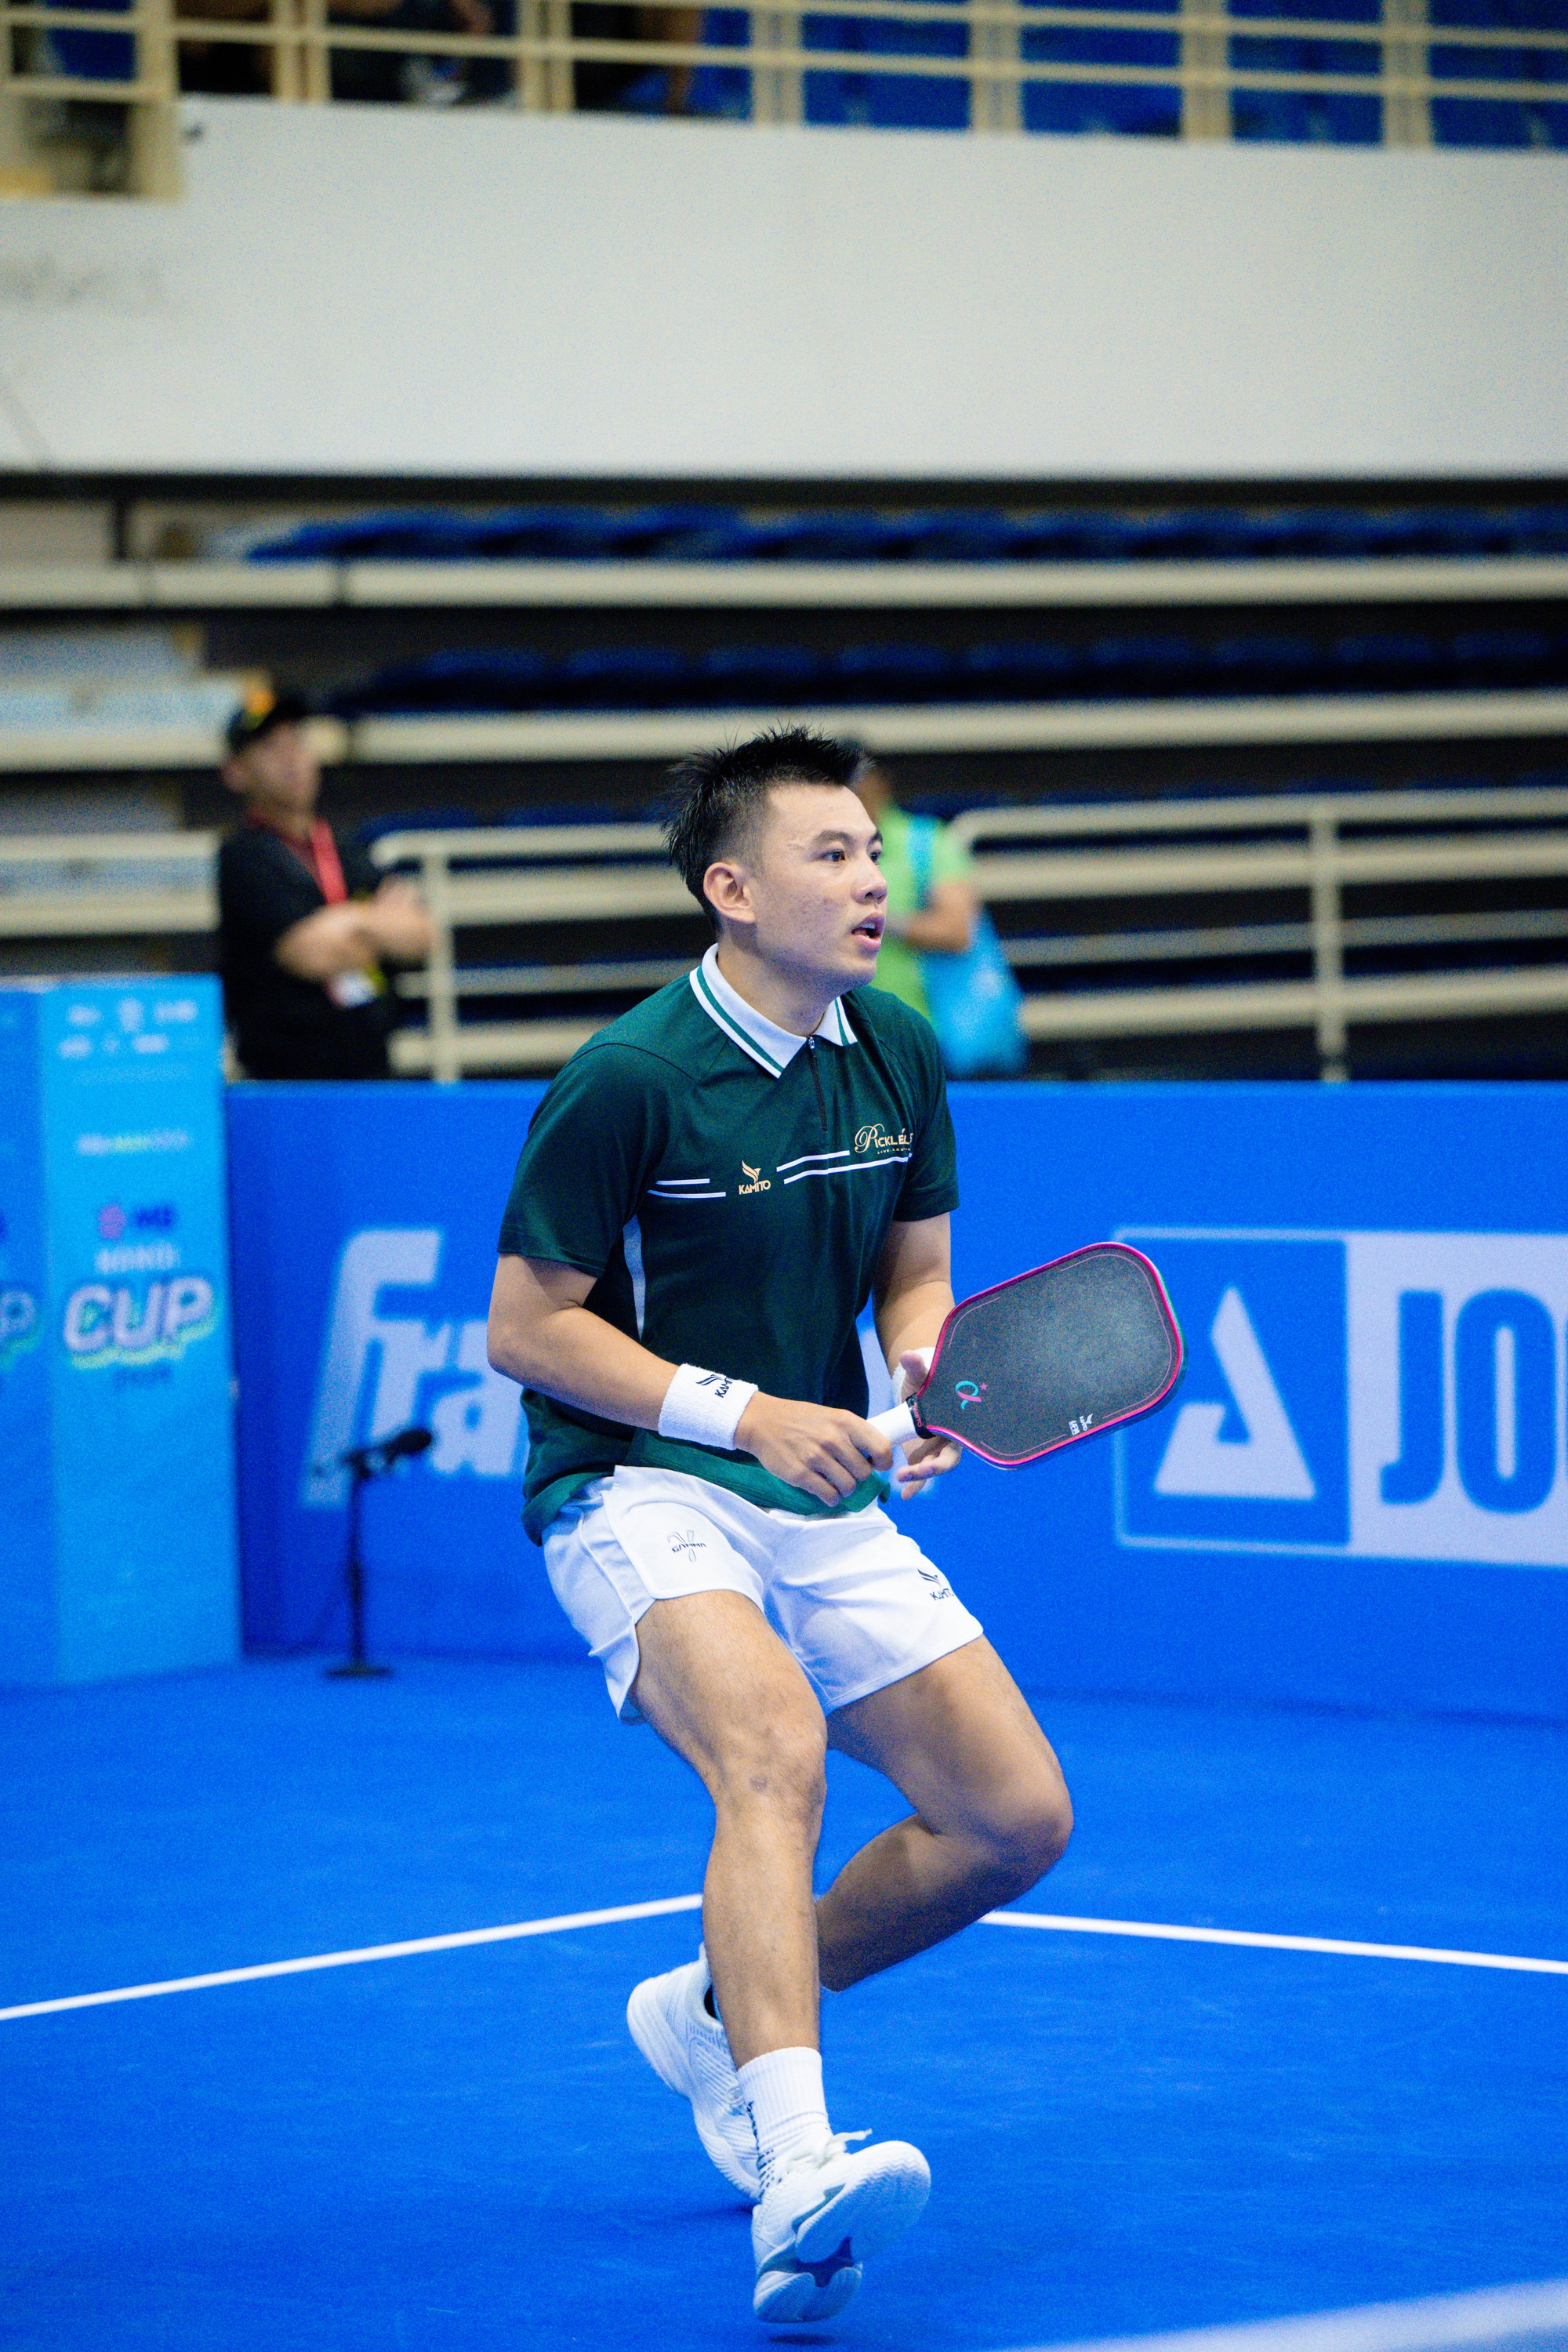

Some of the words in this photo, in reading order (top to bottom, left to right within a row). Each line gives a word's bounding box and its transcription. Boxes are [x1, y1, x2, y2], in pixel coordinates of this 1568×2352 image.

[738, 1179, 771, 1195] KAMITO
[64, 1276, 214, 1354] CUP
[303, 1229, 524, 1504] Fra
[1381, 1287, 1568, 1515] JO
